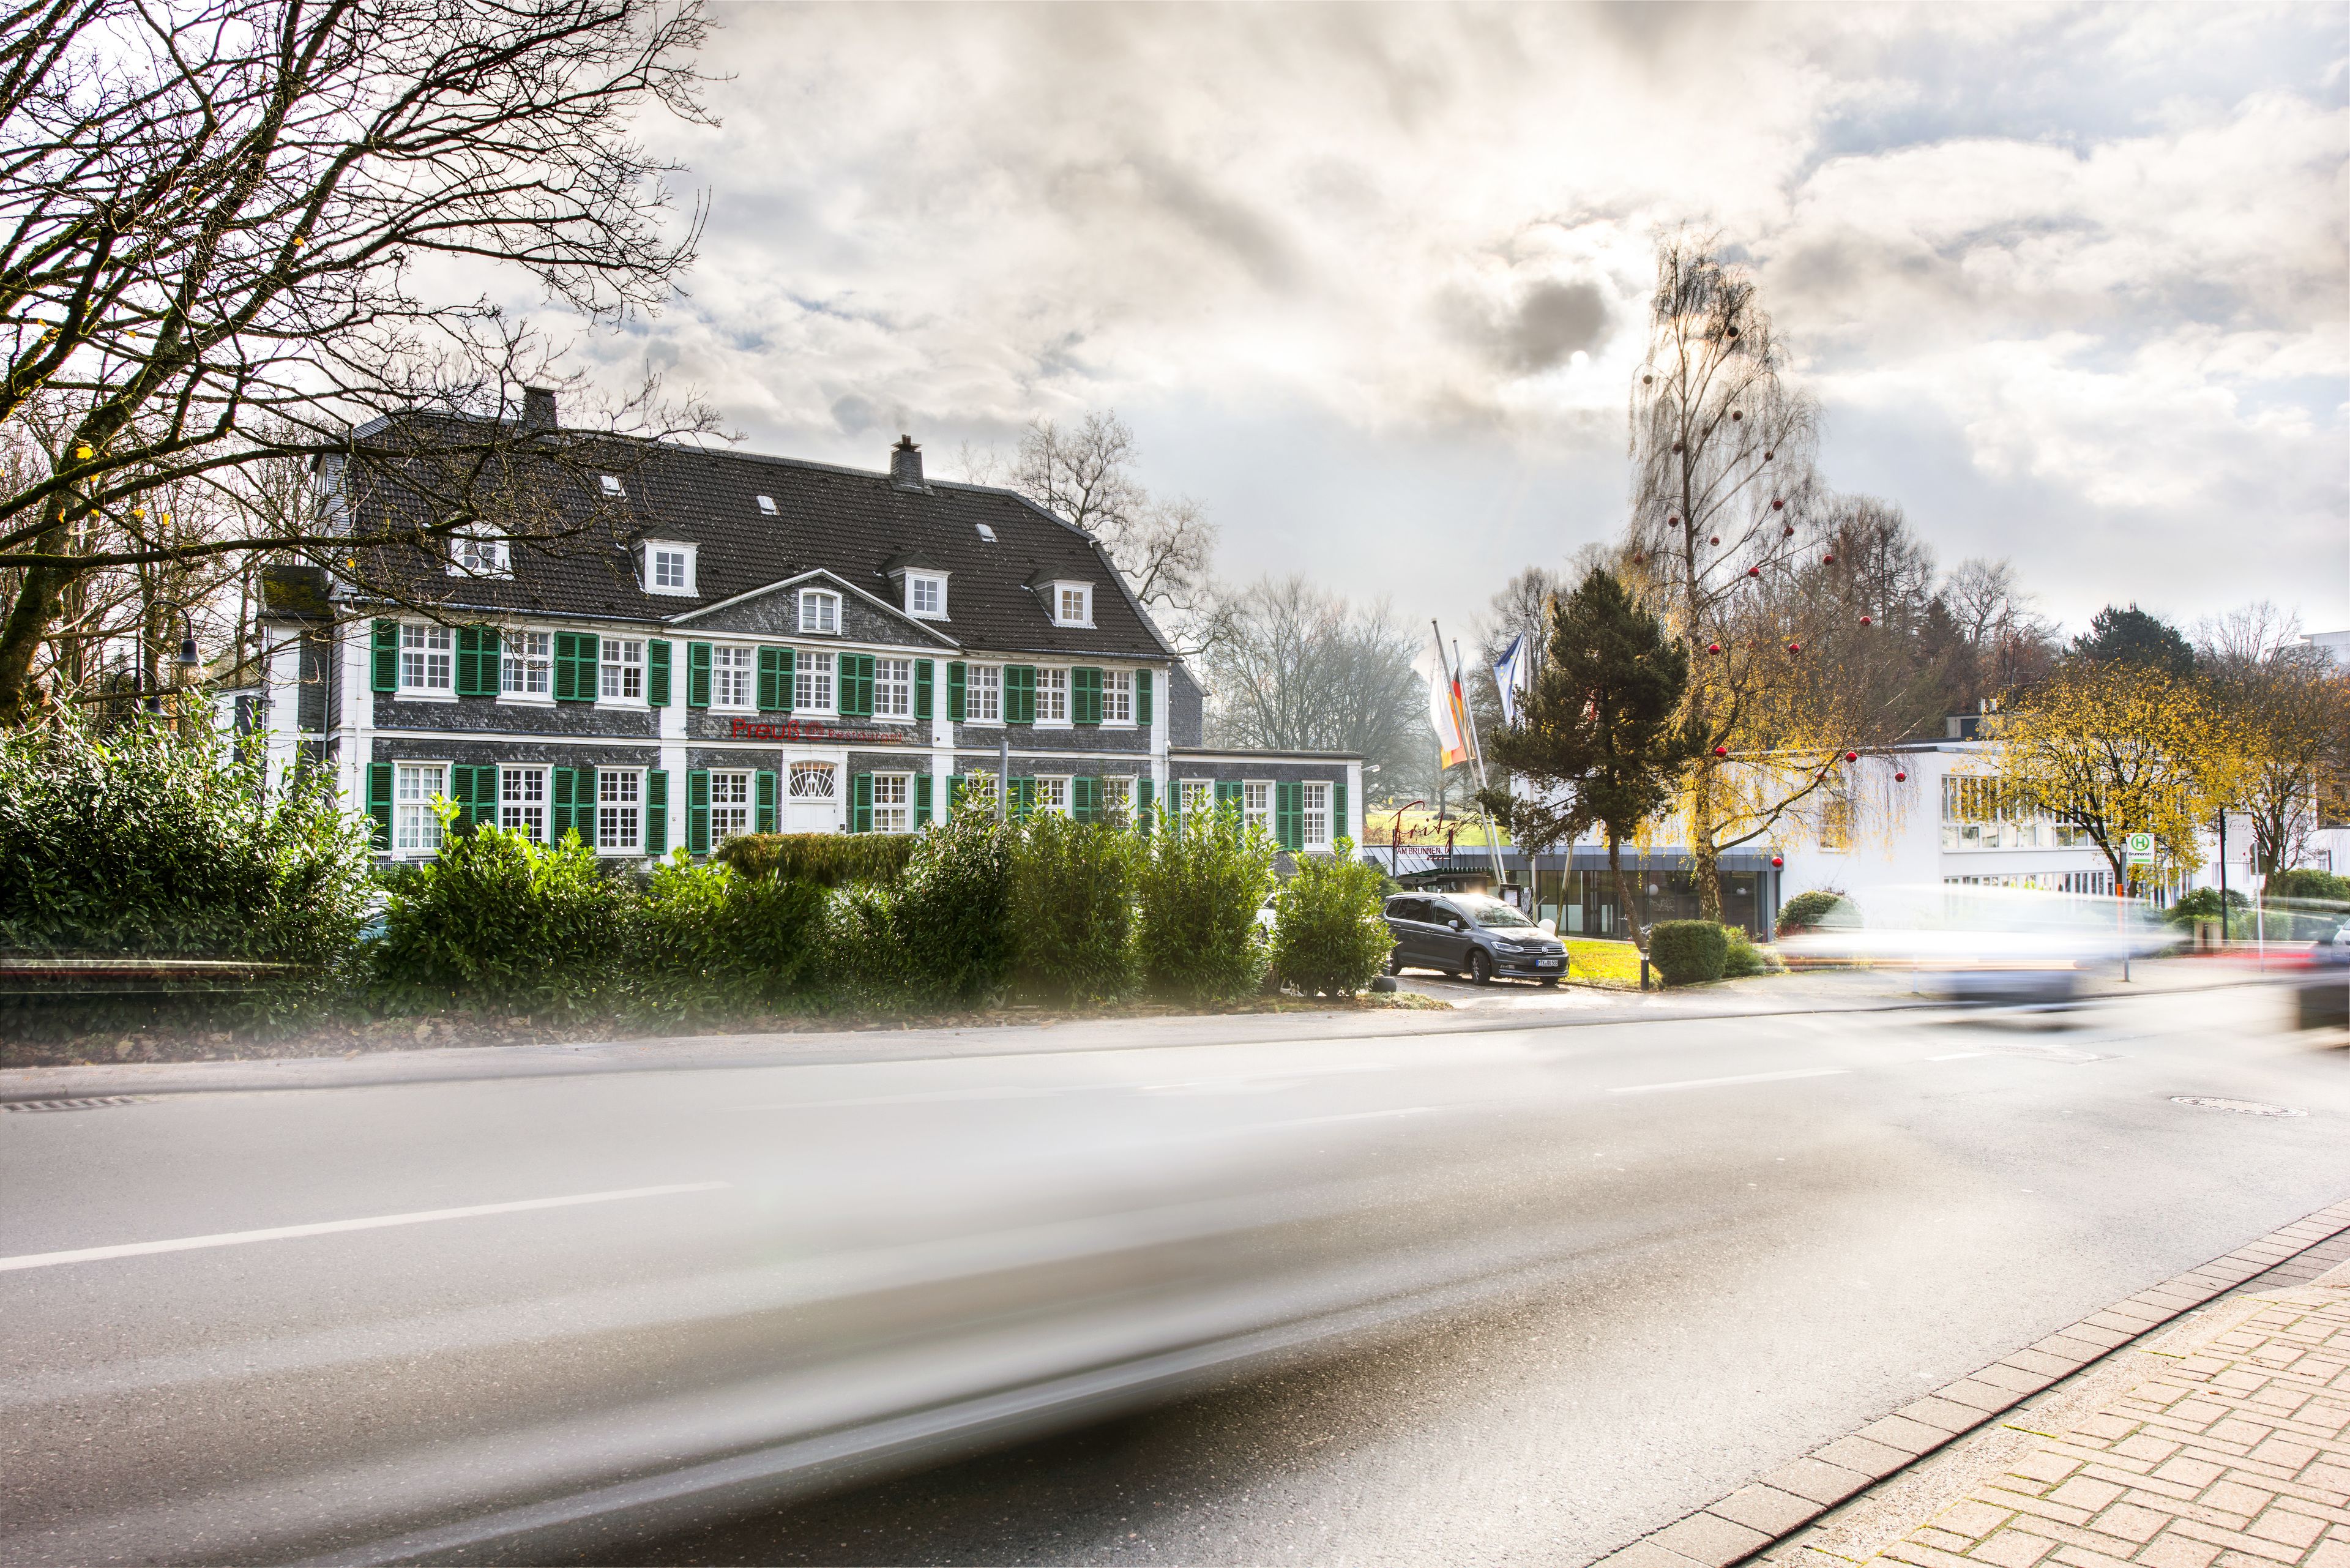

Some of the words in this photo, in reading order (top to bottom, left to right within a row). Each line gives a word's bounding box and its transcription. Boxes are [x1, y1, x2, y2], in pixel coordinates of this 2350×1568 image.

[733, 719, 799, 741] Preuß
[829, 729, 901, 742] Restaurant
[1388, 800, 1456, 854] Fritz
[2135, 838, 2145, 847] H
